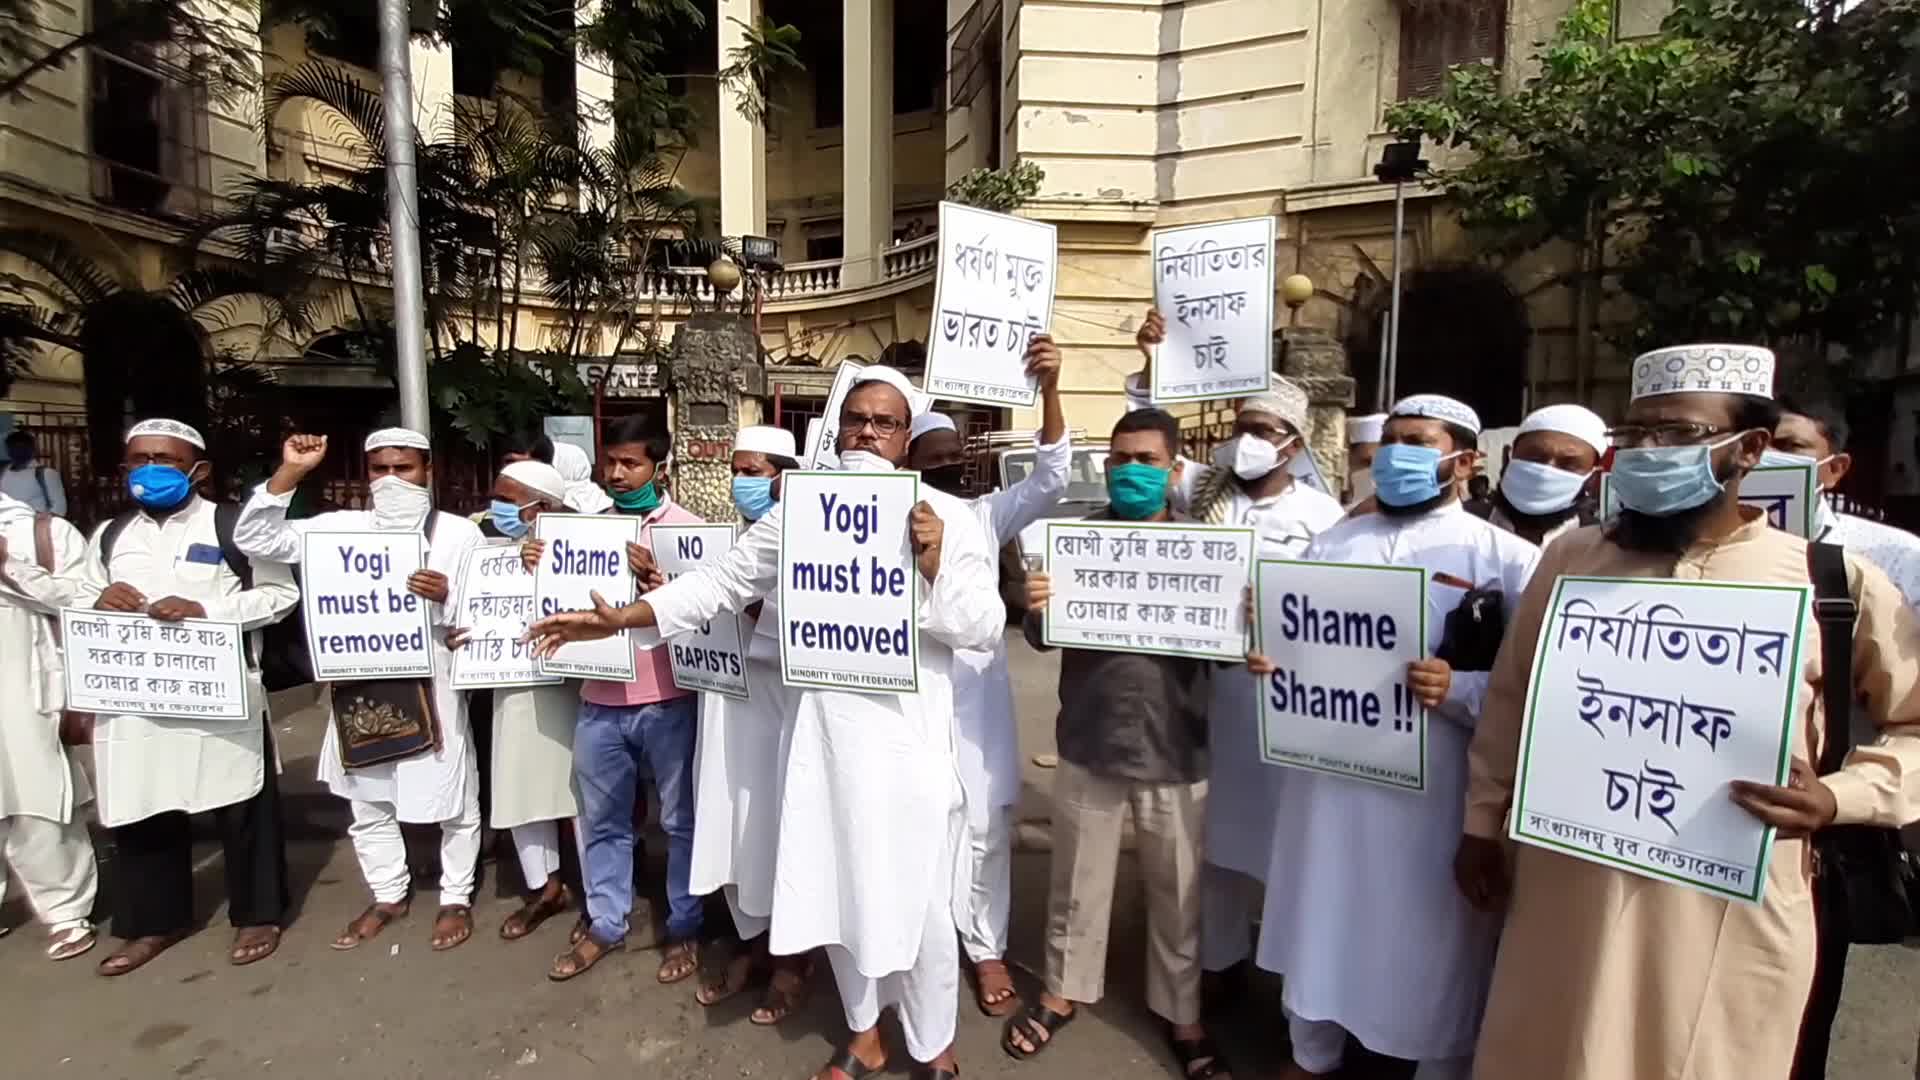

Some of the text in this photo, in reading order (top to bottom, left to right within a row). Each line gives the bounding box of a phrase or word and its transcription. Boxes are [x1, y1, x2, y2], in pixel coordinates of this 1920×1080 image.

[955, 233, 998, 285] ধর্ষণ
[1157, 239, 1266, 283] নির্যাতিতার
[1173, 291, 1248, 328] ইনসাফ
[942, 307, 1002, 349] ভারত
[1192, 335, 1229, 371] চাই
[688, 439, 730, 463] OUT
[819, 492, 878, 545] Yogi
[338, 546, 391, 580] Yogi
[552, 538, 620, 577] Shame
[677, 535, 704, 560] NO
[1055, 530, 1103, 557] যোগী
[1110, 531, 1149, 562] তুমি
[1156, 534, 1195, 561] মঠে
[792, 556, 905, 597] must be
[1074, 568, 1223, 593] সরকার চালানো
[318, 588, 417, 615] must be
[1066, 600, 1130, 621] তোমার
[1137, 604, 1177, 624] কাজ
[70, 618, 110, 640] যোগী
[117, 620, 153, 644] তুমি
[790, 619, 909, 657] removed
[1281, 592, 1397, 650] Shame
[1558, 599, 1790, 678] নির্যাতিতার
[319, 626, 424, 654] removed
[88, 648, 216, 671] সরকার চালানো
[674, 644, 741, 676] RAPISTS
[789, 668, 914, 687] MINORITY YOUTH FEDERATION
[84, 673, 140, 692] তোমার
[146, 678, 183, 696] কাজ
[1270, 667, 1380, 727] Shame
[1577, 668, 1736, 753] ইনসাফ
[1602, 759, 1684, 836] চাই
[1529, 814, 1746, 885] সংখ্যালঘু যুব ফেডারেশন
